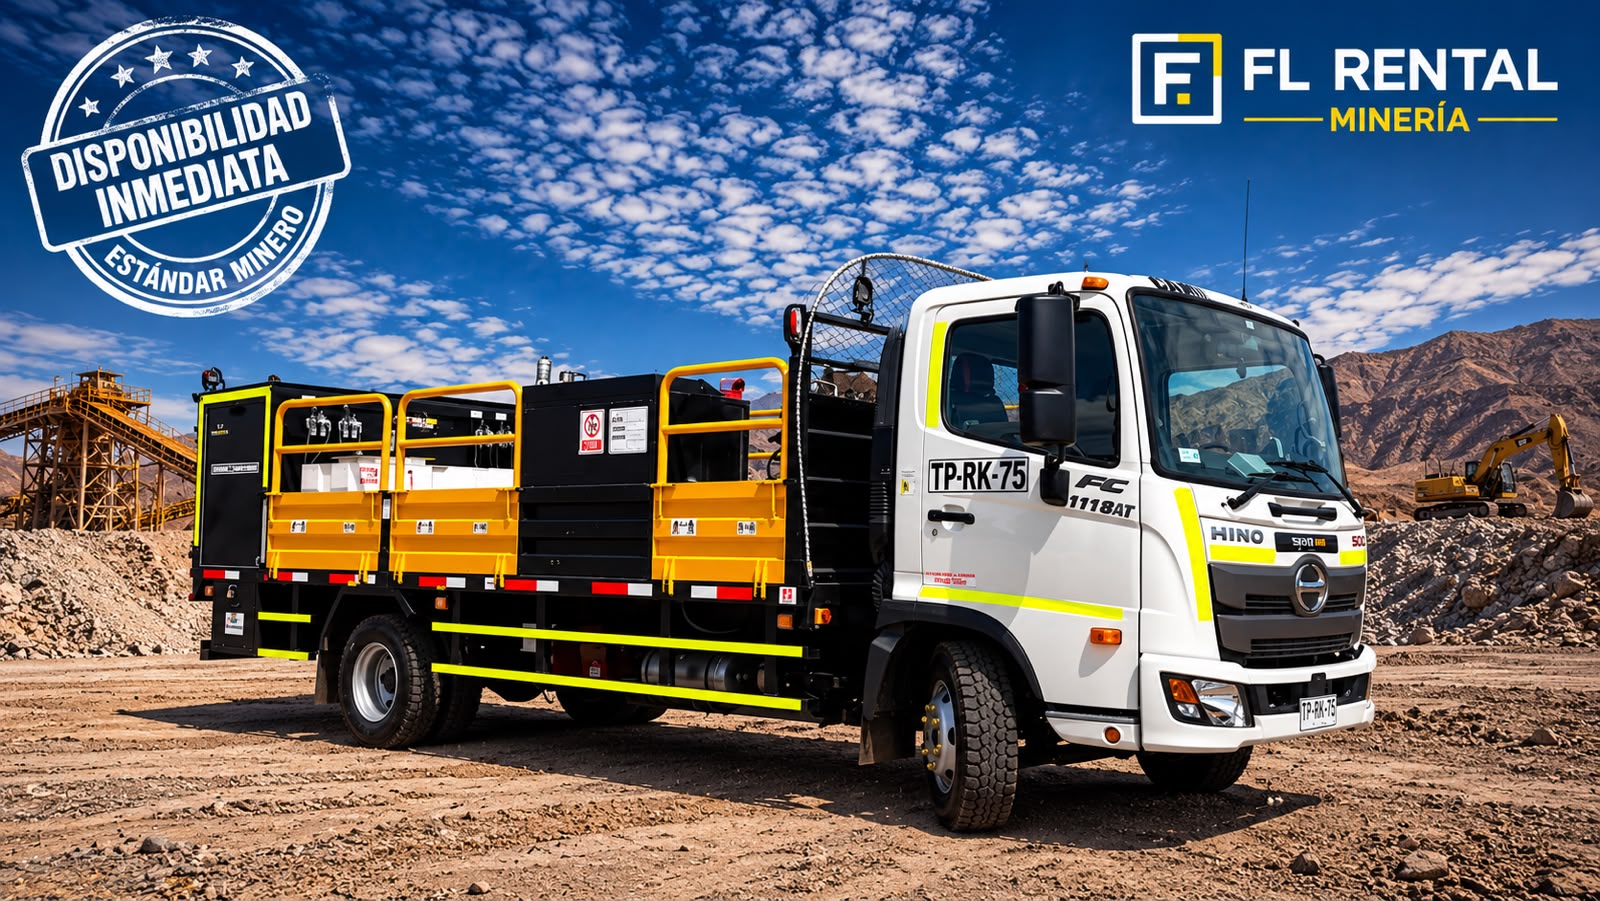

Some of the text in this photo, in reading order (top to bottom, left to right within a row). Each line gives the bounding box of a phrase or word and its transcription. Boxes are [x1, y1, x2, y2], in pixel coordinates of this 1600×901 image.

[931, 460, 1026, 490] TP-RK-75
[1075, 474, 1129, 494] FC
[1069, 495, 1136, 518] 1118AT
[1211, 526, 1264, 544] HINO
